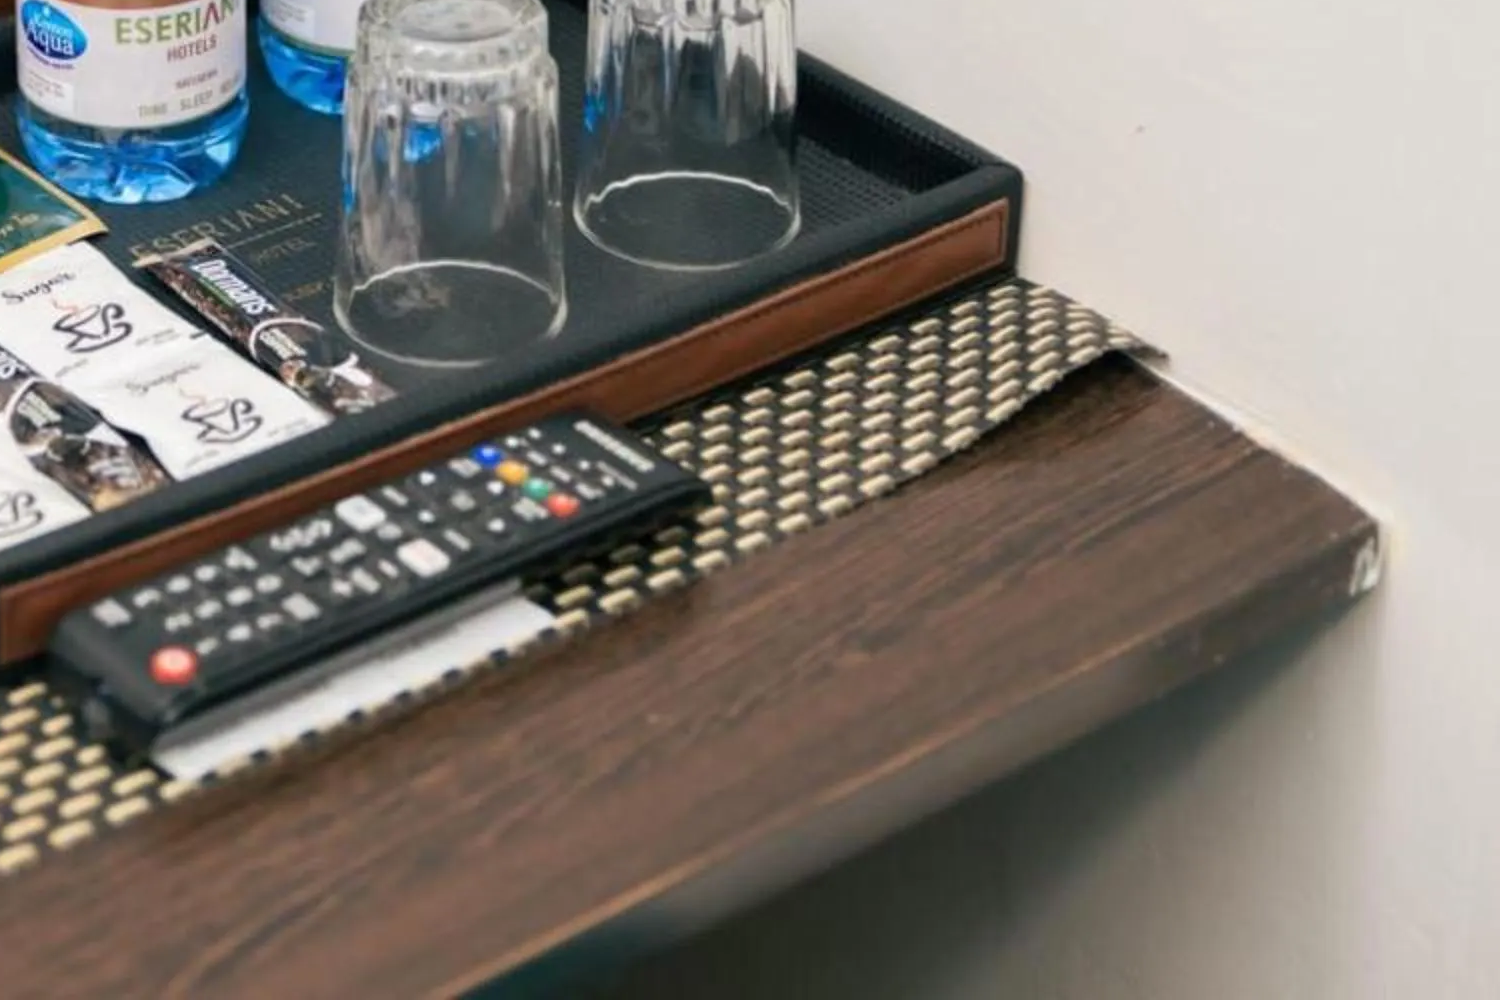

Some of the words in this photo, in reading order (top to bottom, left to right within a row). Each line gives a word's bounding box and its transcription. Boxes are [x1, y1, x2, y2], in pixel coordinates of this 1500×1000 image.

[27, 17, 75, 56] Aqua
[167, 33, 218, 63] HOTELS
[1, 269, 78, 306] Sugar
